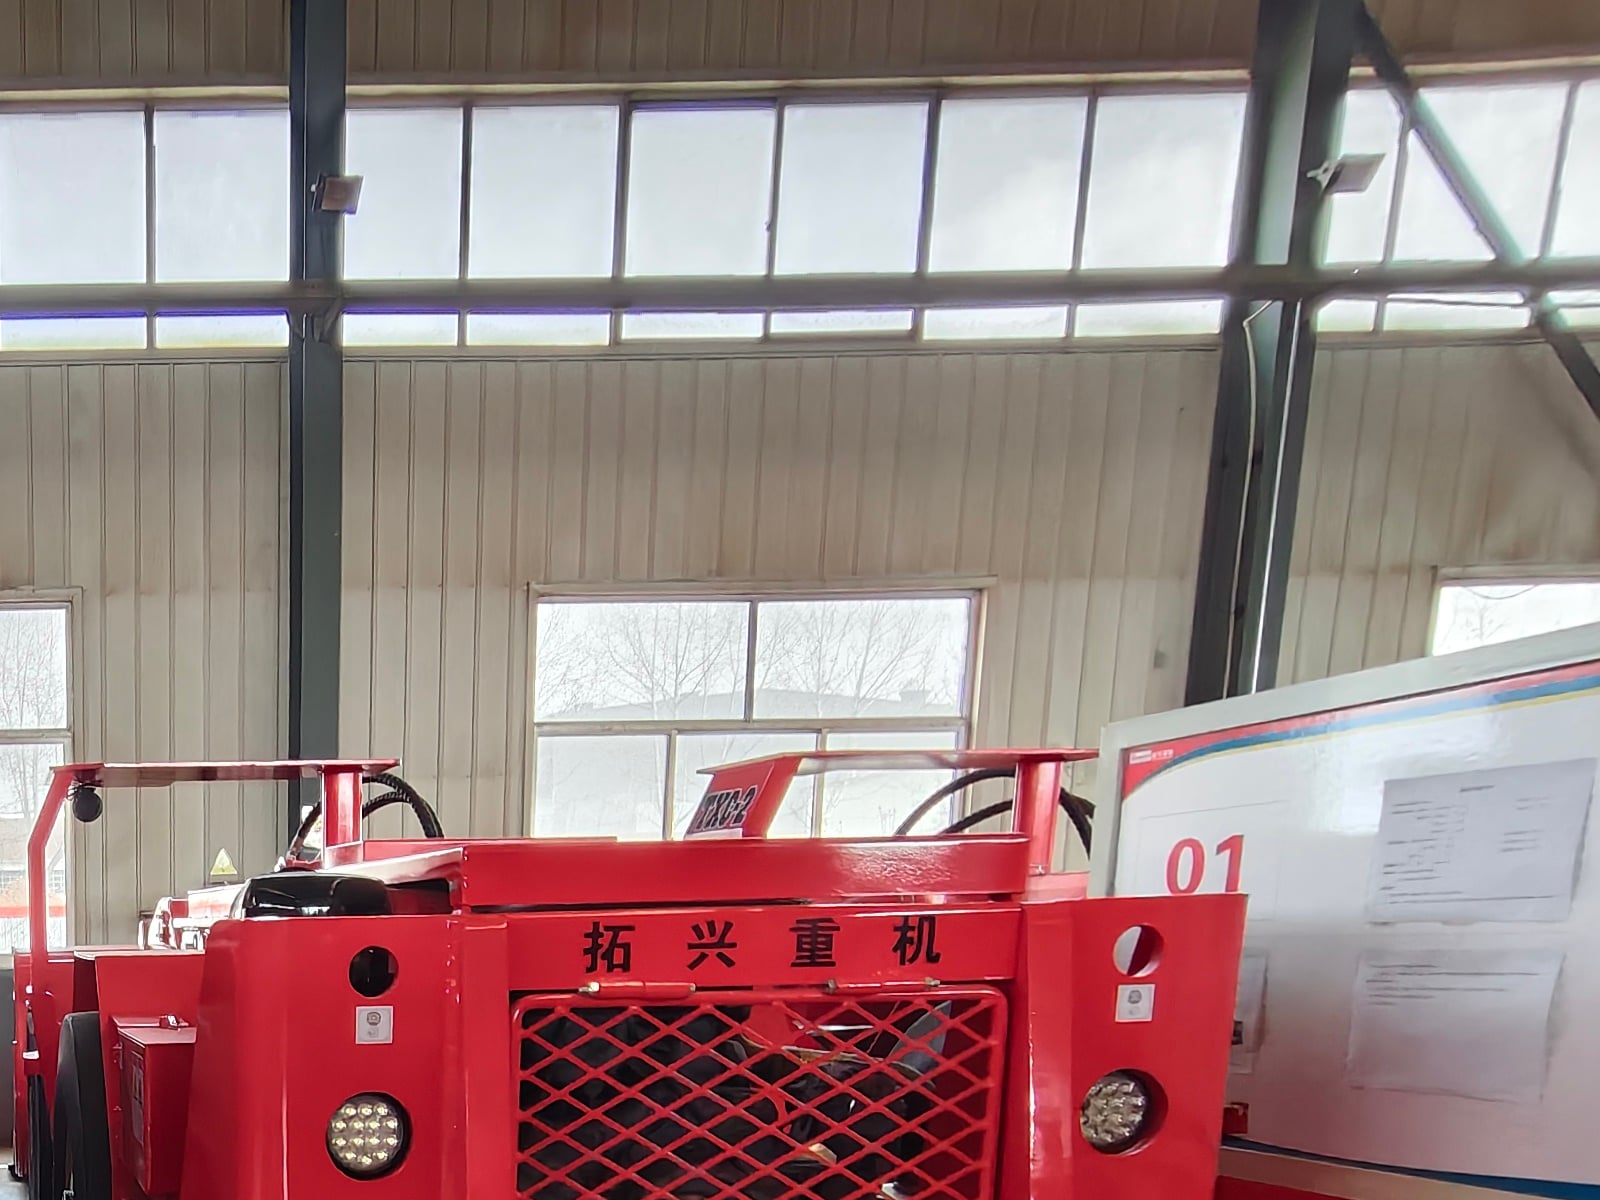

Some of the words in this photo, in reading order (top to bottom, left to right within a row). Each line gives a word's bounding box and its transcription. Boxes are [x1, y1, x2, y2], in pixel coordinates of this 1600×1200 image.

[1166, 834, 1244, 893] 01
[582, 912, 942, 974] 拓兴重机
